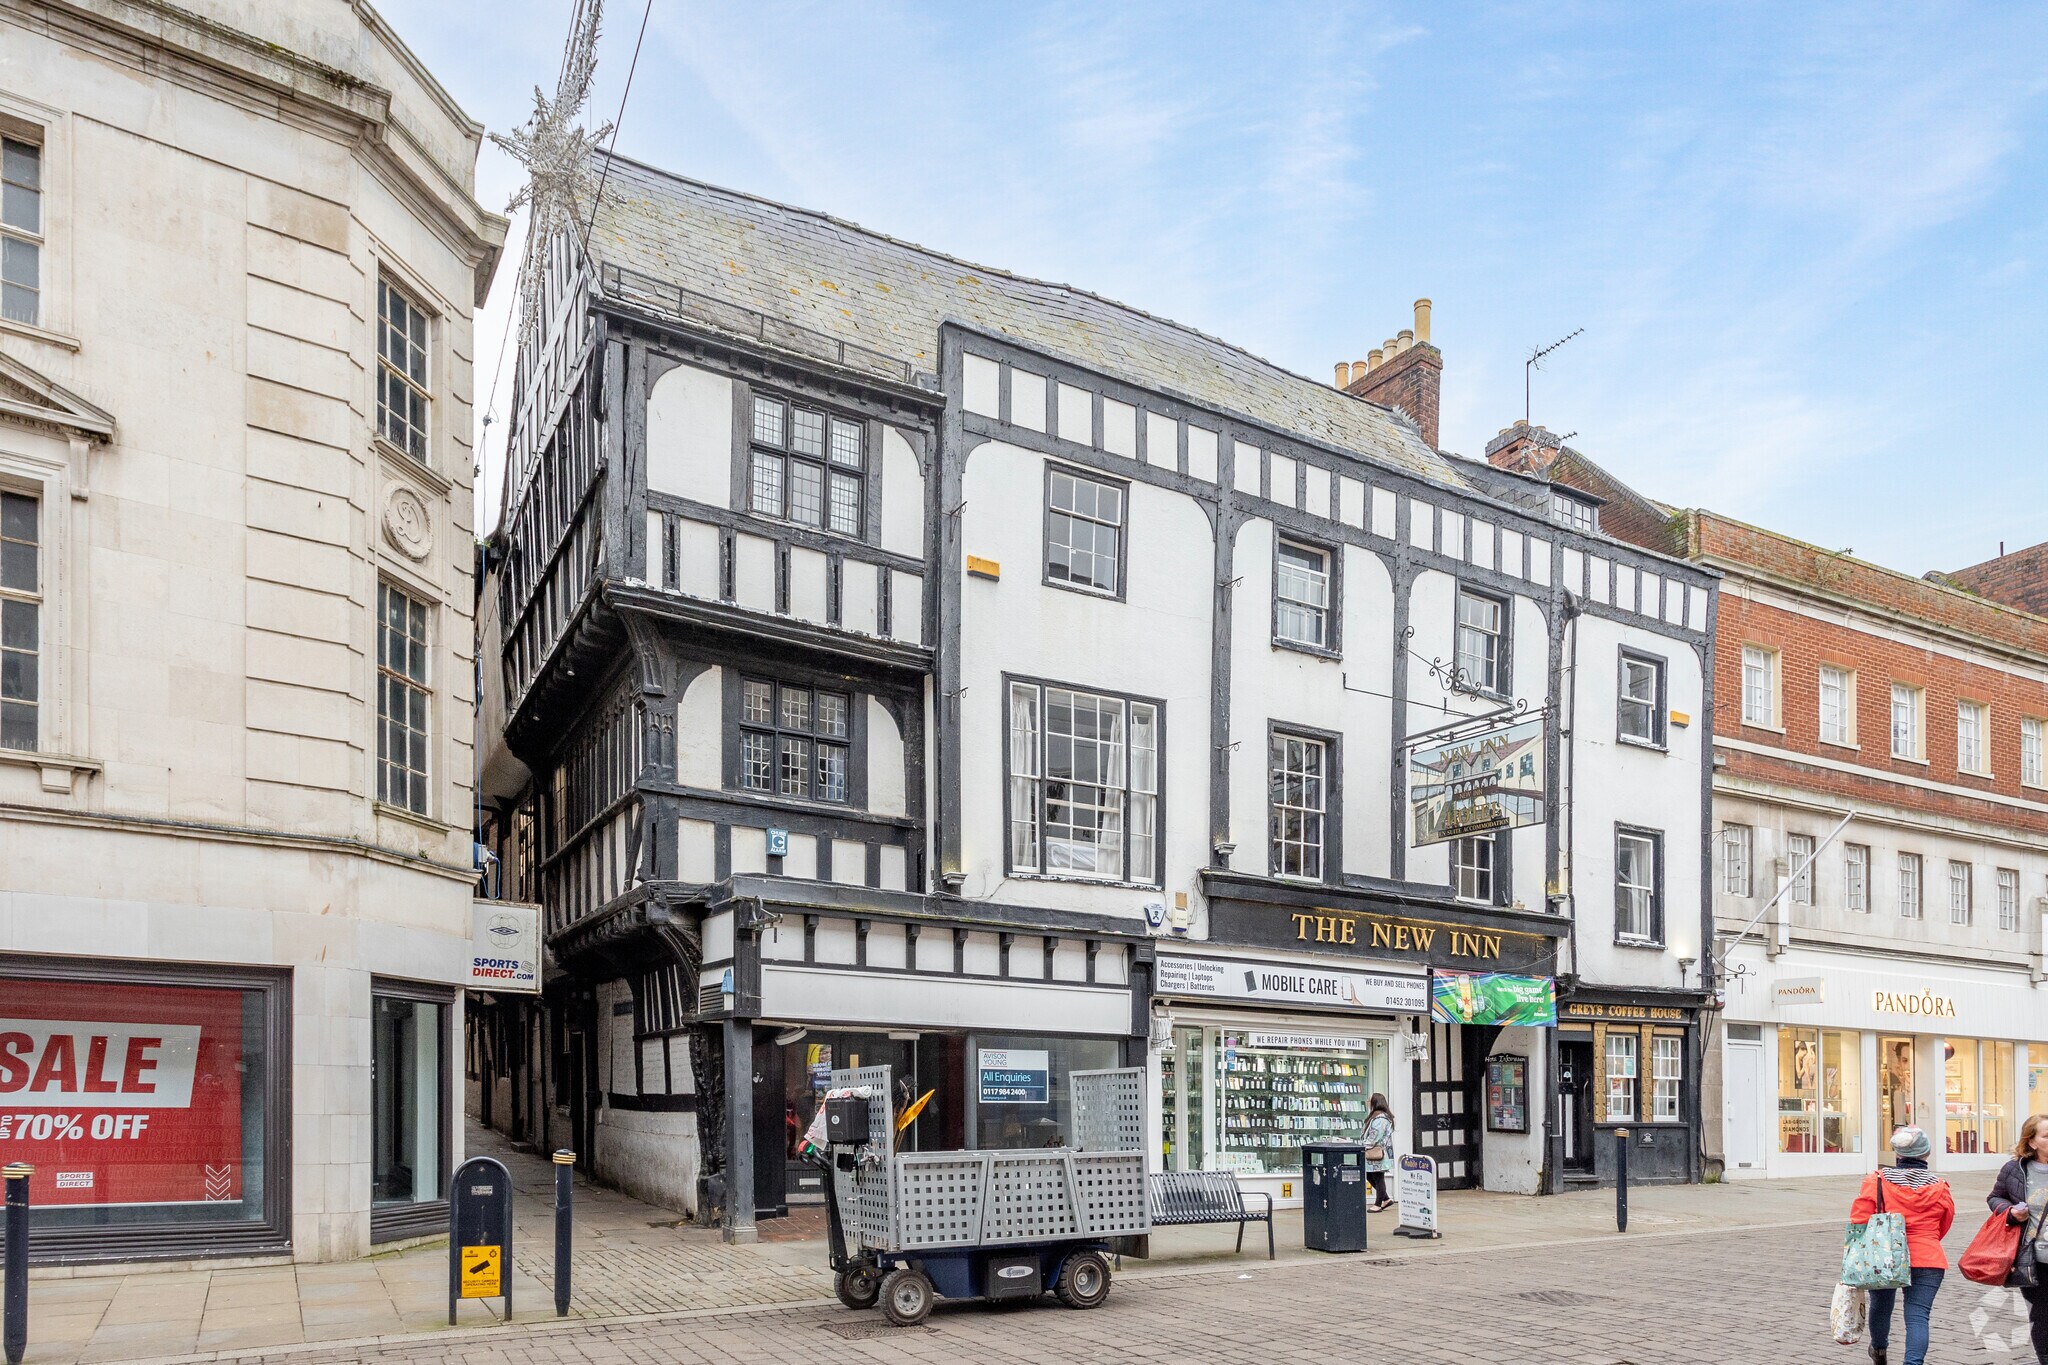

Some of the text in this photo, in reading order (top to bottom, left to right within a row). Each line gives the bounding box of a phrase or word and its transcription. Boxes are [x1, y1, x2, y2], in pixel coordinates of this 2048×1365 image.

[1439, 733, 1510, 765] NEW INN
[1446, 802, 1502, 828] HOTEL
[1291, 913, 1501, 960] THE NEW INN
[473, 957, 519, 970] SPORTS
[1160, 960, 1224, 974] Accessories Unlocking
[472, 968, 534, 981] DIRECT.COM
[1160, 969, 1213, 982] Repairing Laptops
[1160, 980, 1215, 991] Chargers Batteries
[1262, 974, 1338, 996] MOBILE CARE
[1407, 981, 1425, 990] PHONES
[1512, 984, 1524, 995] big
[1524, 987, 1543, 995] game
[1385, 996, 1425, 1007] 01452 301095
[1516, 994, 1529, 1003] live
[1569, 1003, 1682, 1020] GREY'S COFFEE HOUSE
[1256, 1035, 1361, 1048] WE REPAIR PHONES WHILE YOU WAIT
[0, 1031, 162, 1094] SALE
[983, 1071, 1032, 1083] All Enquiries
[14, 1114, 83, 1140] 70%
[91, 1114, 150, 1140] OFF
